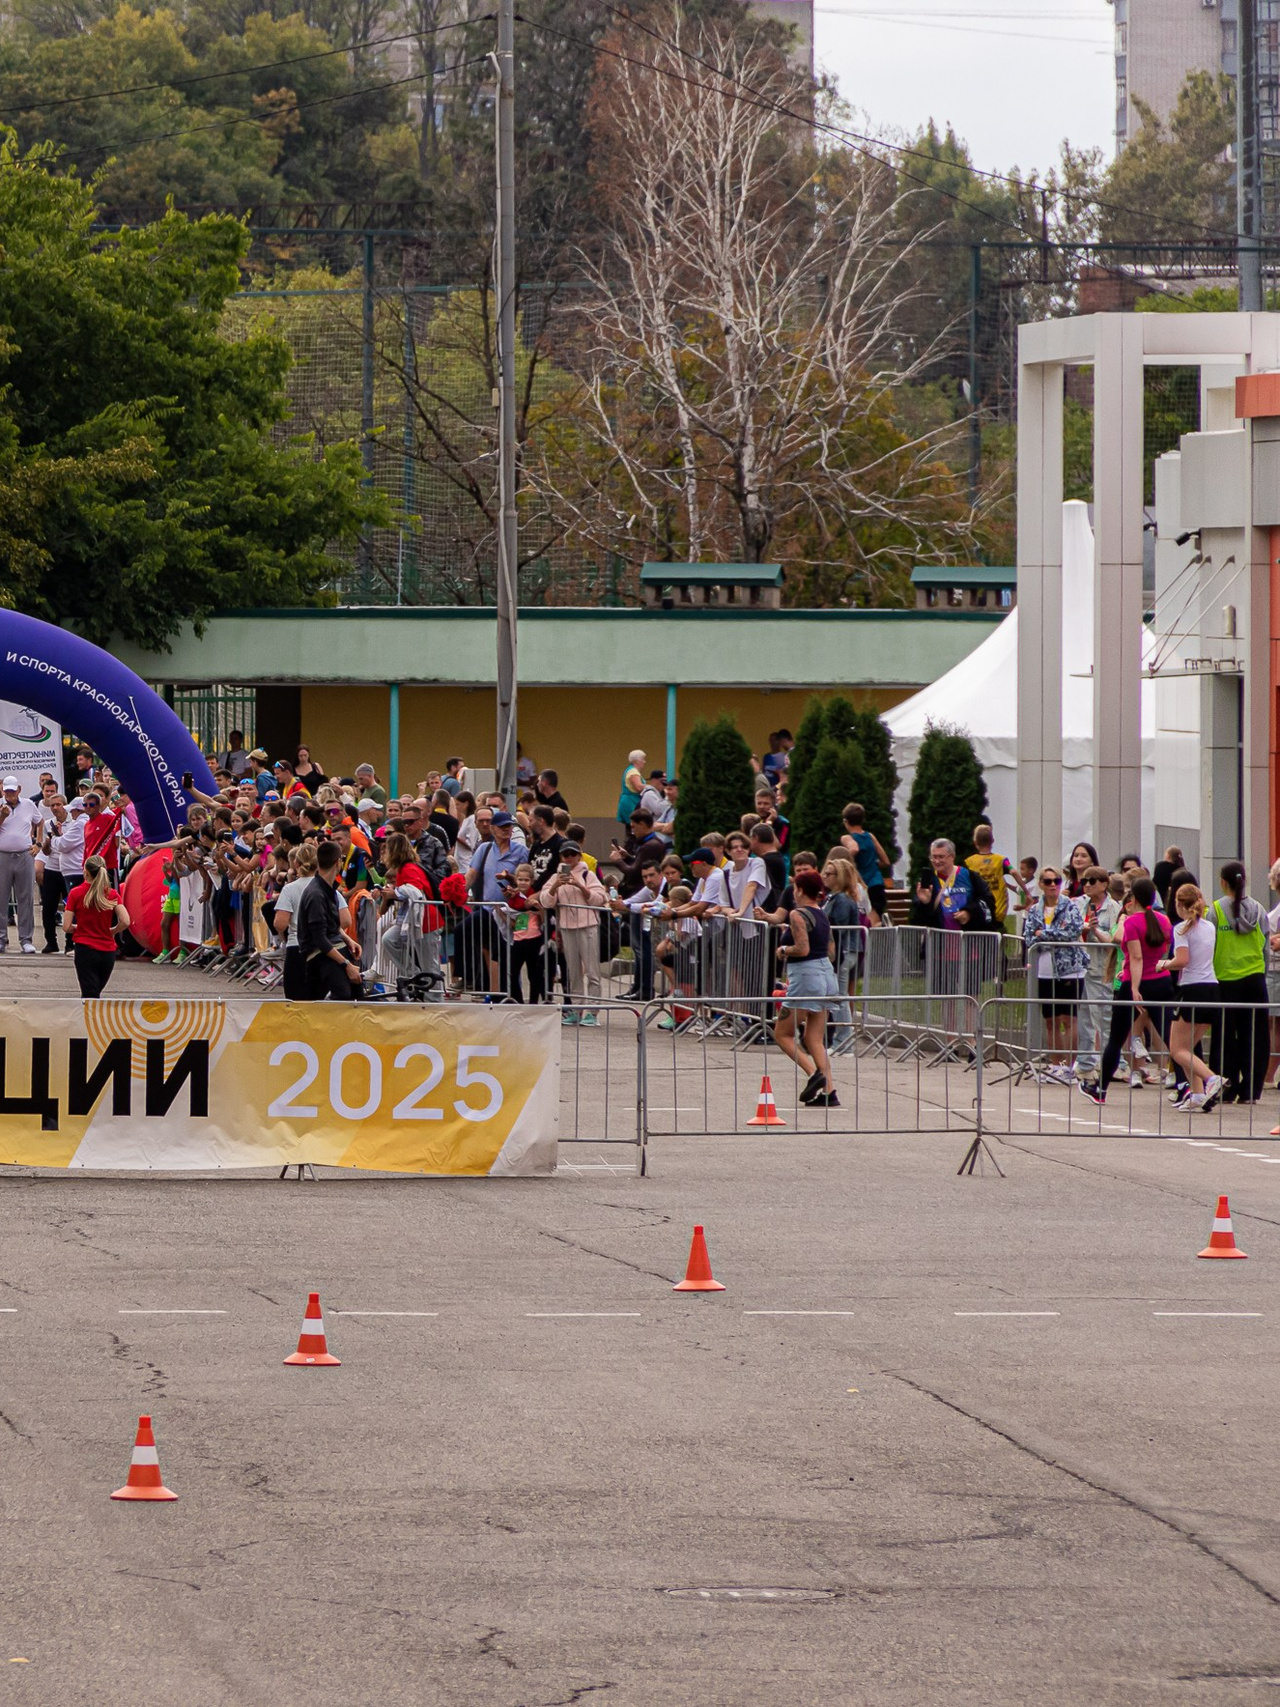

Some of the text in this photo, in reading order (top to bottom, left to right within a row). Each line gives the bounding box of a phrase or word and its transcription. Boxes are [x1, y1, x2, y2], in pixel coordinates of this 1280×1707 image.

[6, 651, 187, 808] И СПОРТА КРАСНОДАРСКОГО КРАЯ
[267, 1040, 504, 1121] 2025
